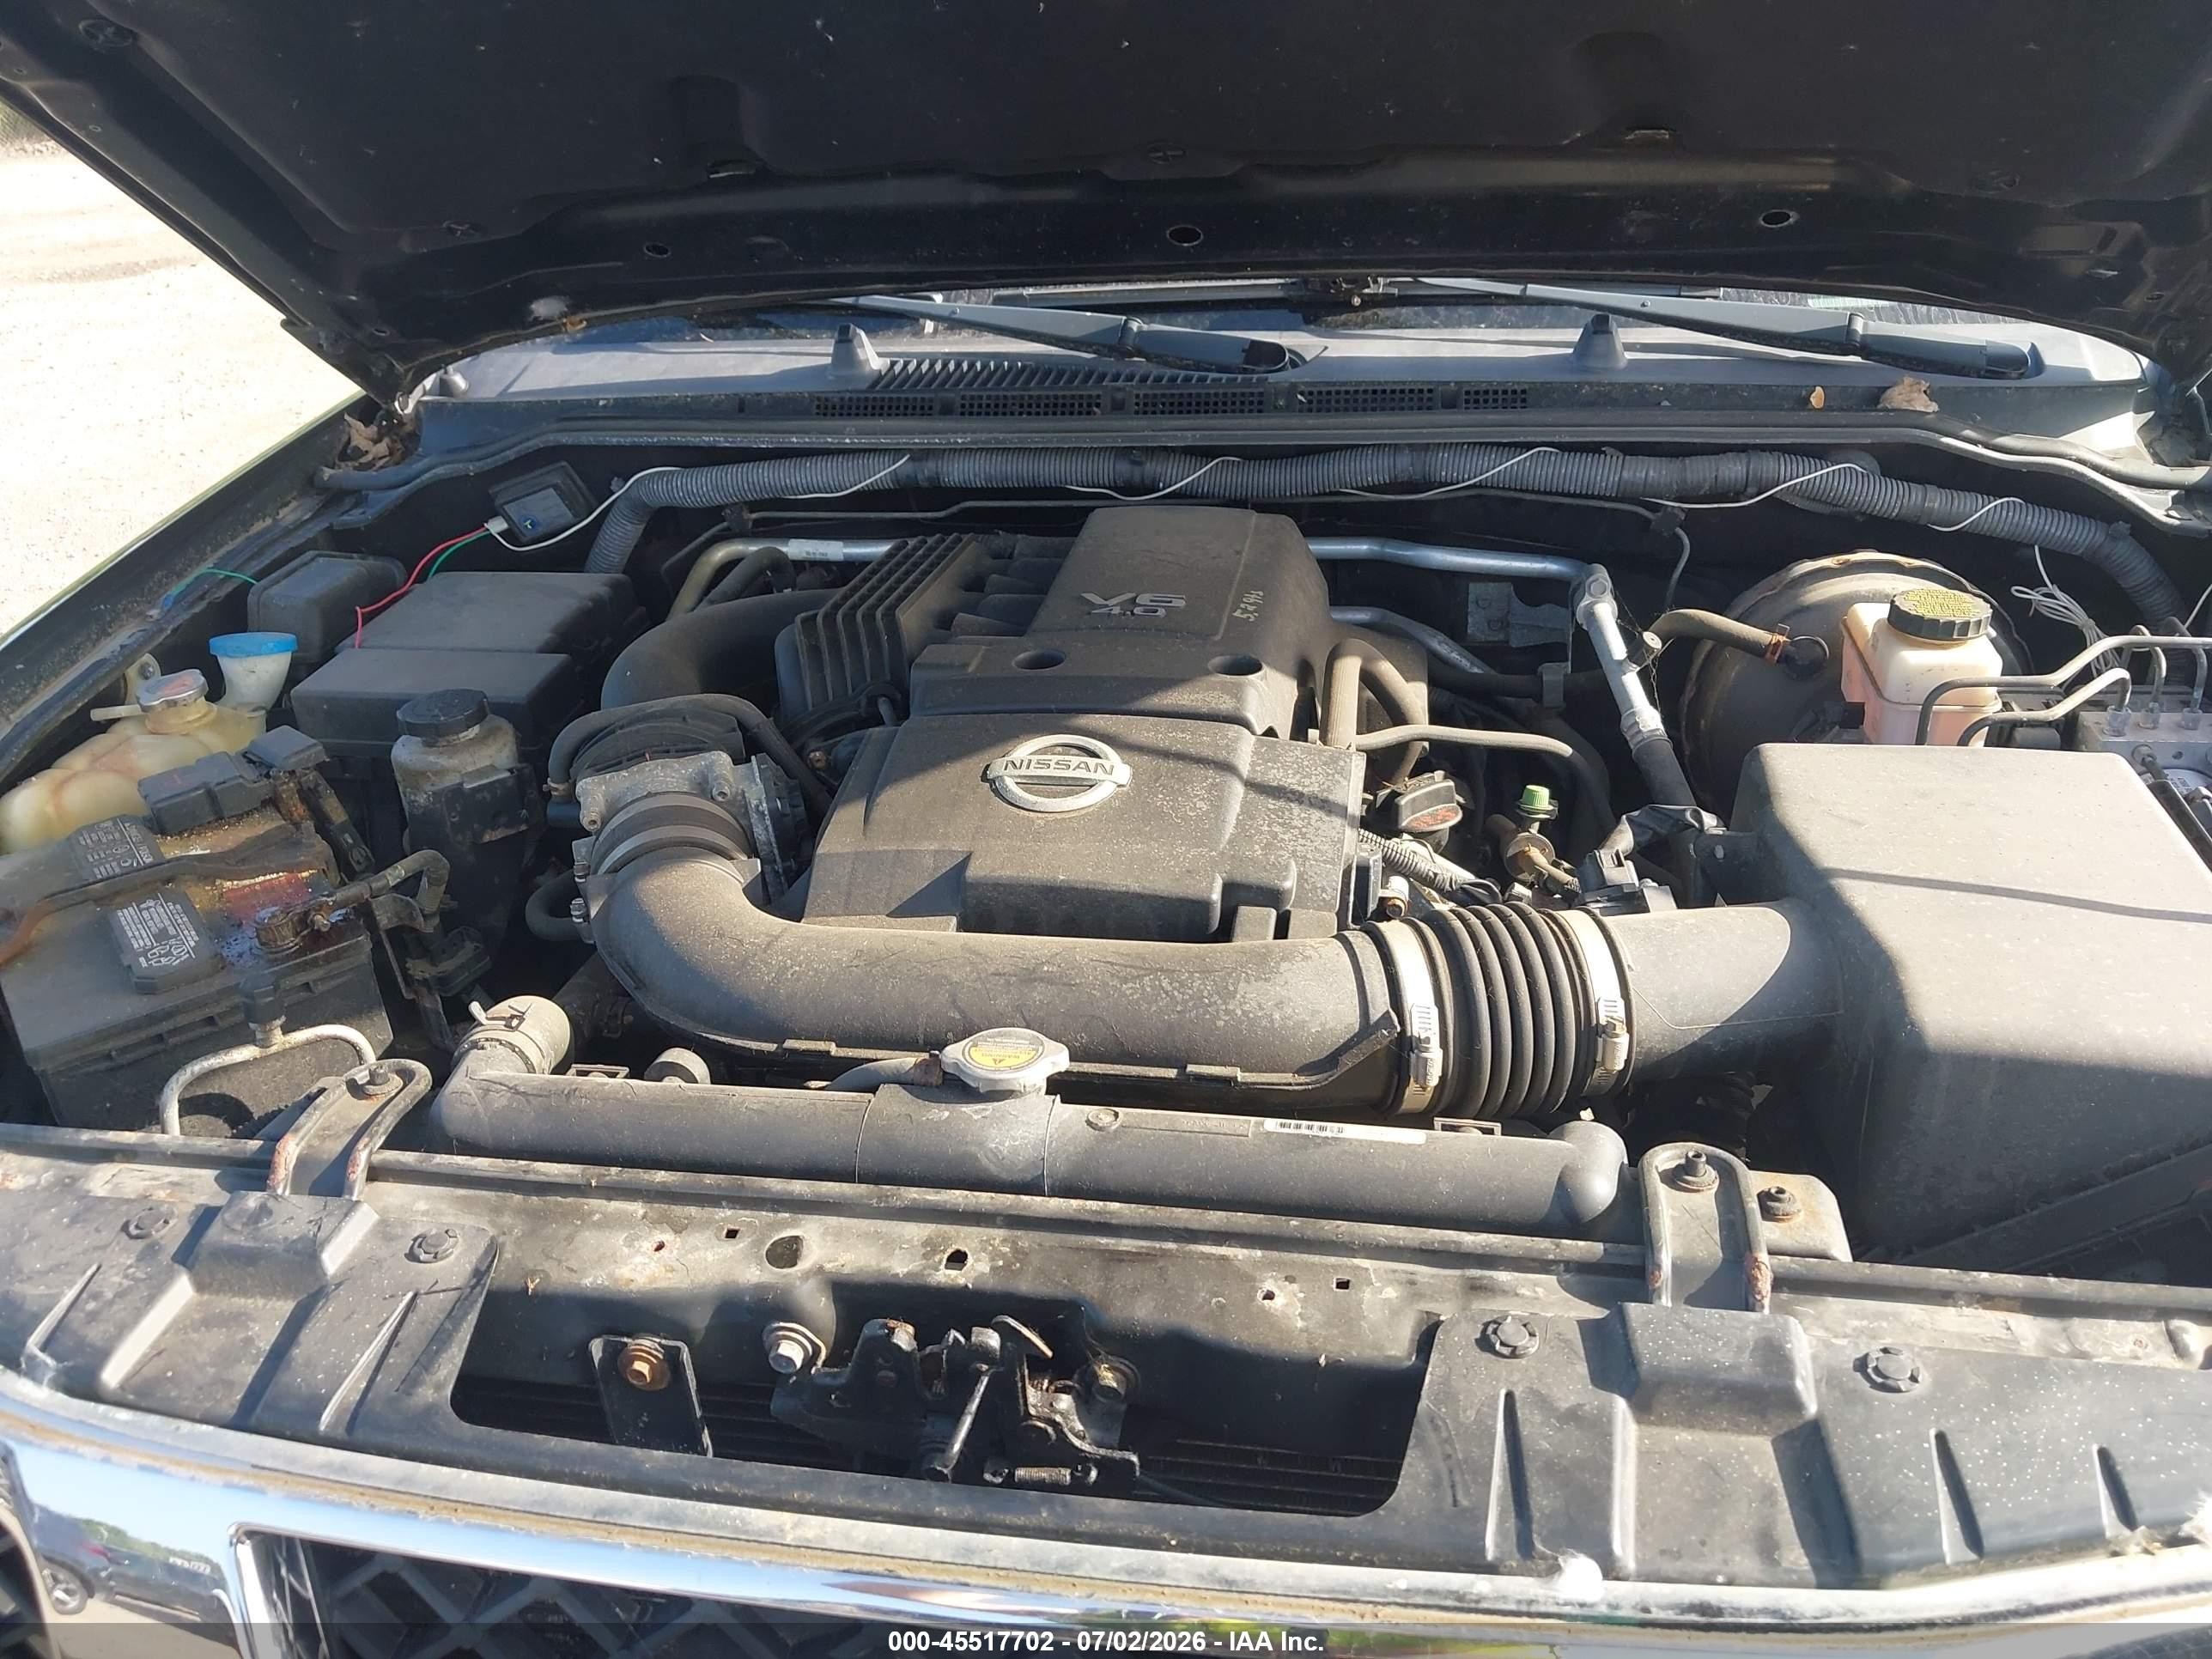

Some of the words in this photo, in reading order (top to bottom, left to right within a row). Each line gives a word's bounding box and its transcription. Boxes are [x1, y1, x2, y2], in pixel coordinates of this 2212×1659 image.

[1080, 592, 1187, 610] V6
[1089, 605, 1168, 618] 4.0
[1003, 758, 1115, 776] NISSAN
